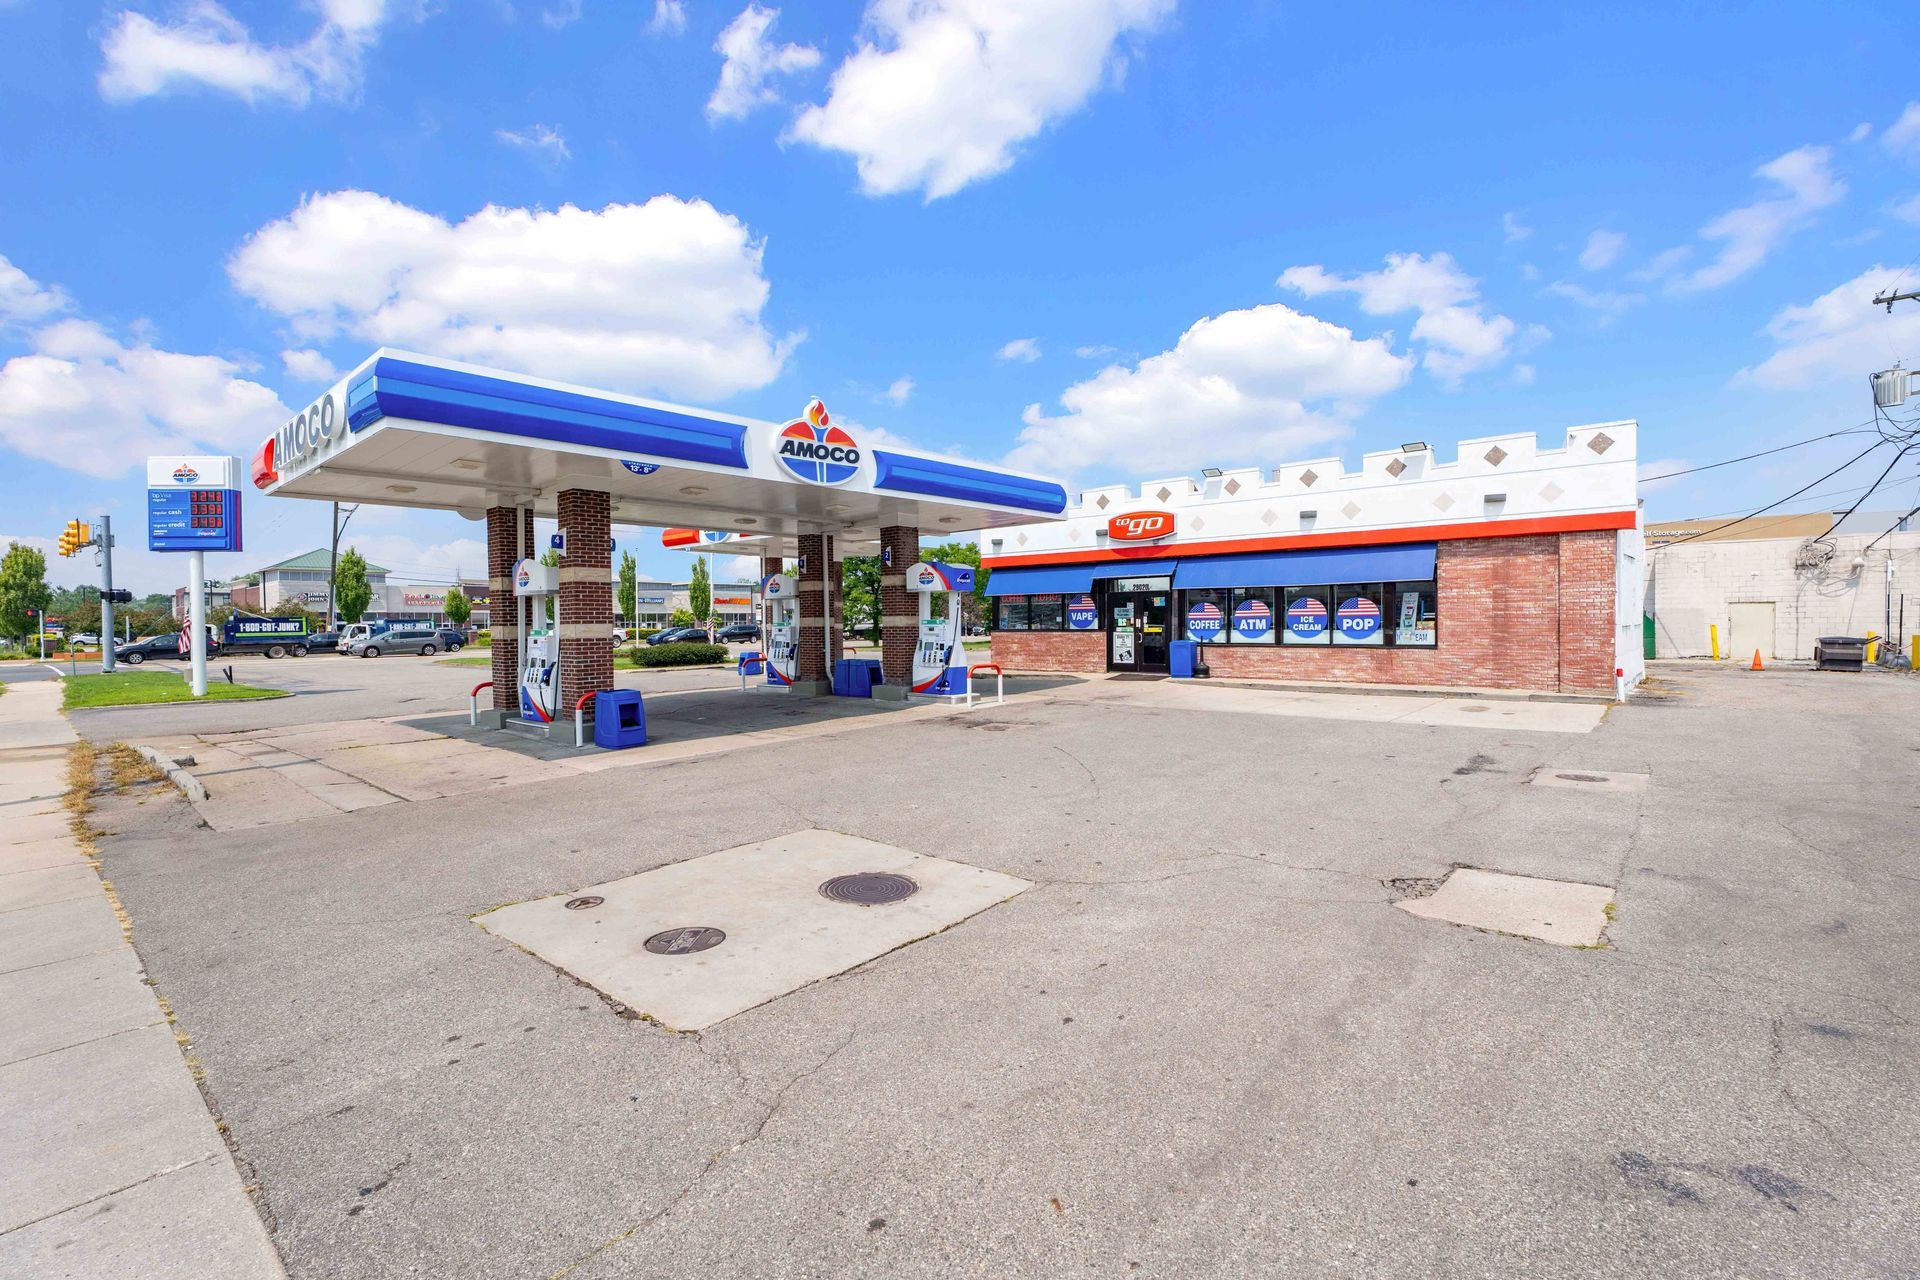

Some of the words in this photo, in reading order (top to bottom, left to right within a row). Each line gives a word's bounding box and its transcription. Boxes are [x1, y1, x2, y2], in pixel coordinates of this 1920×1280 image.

[274, 394, 334, 470] AMOCO
[779, 440, 860, 464] AMOCO
[168, 520, 185, 528] credit
[1116, 518, 1130, 526] to
[1126, 517, 1163, 536] go
[554, 536, 560, 544] 4
[1071, 612, 1093, 621] VAPE
[240, 622, 300, 632] 1-800-GOT-JUNK?
[1189, 620, 1220, 630] COFFEE
[1240, 618, 1267, 630] ATM
[1293, 623, 1322, 631] CREAM
[1342, 618, 1375, 631] POP
